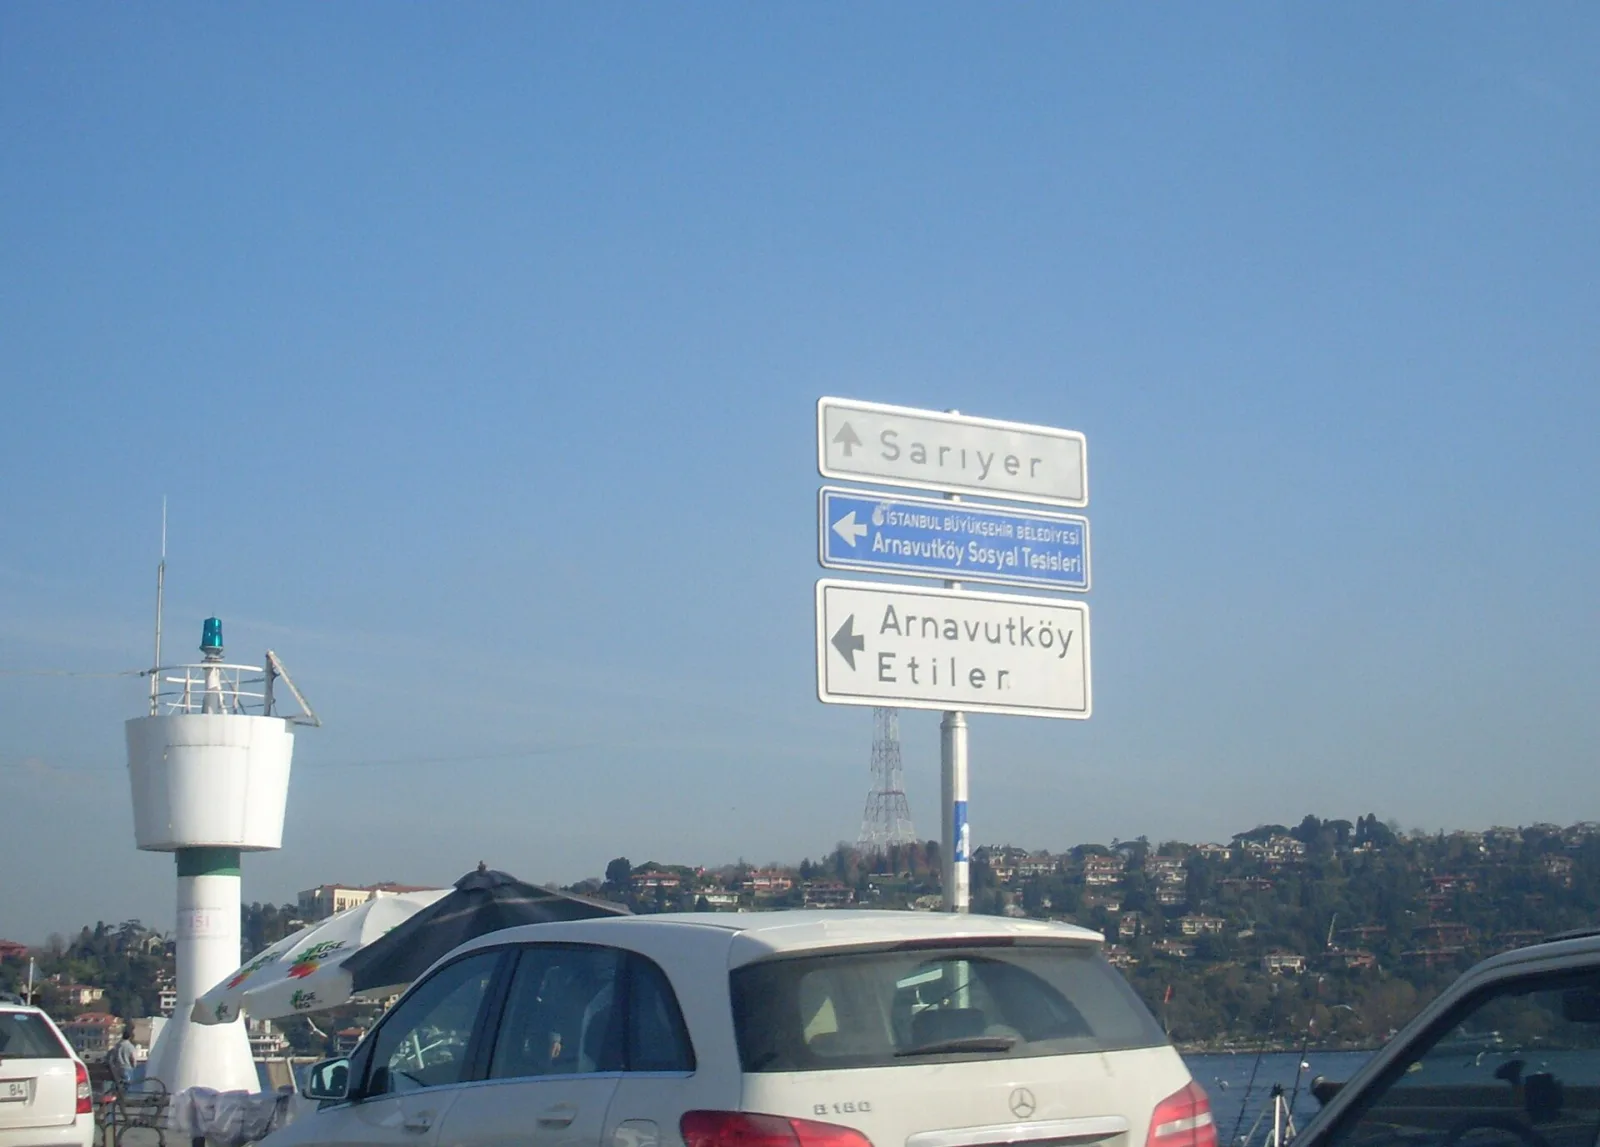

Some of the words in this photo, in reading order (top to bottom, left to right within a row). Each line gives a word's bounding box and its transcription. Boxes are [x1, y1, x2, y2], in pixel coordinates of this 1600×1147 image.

[880, 430, 1043, 480] Sarıyer
[872, 531, 964, 566] Arnavutköy
[968, 540, 1018, 570] Sosyal
[1021, 546, 1081, 573] Tesisleri
[879, 604, 1074, 659] Arnavutköy
[878, 652, 1010, 690] Etiler
